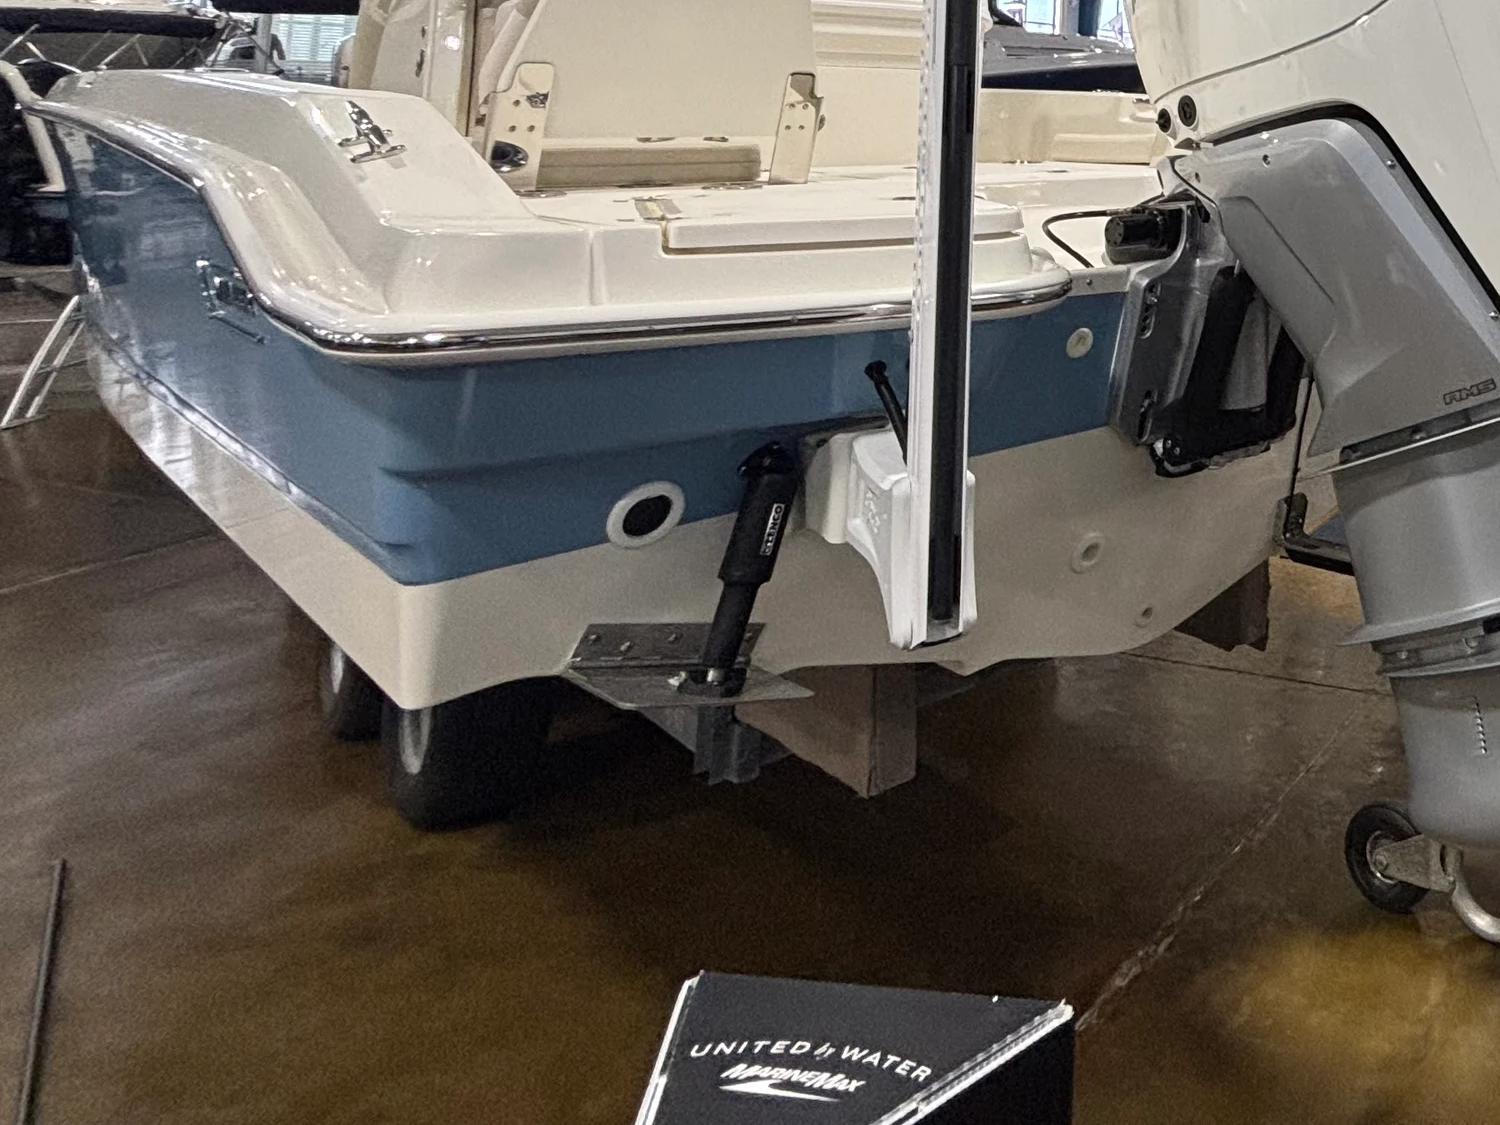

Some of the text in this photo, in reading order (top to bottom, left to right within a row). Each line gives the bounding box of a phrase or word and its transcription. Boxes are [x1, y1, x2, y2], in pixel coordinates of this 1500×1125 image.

[690, 1040, 933, 1082] UNITED by WATER
